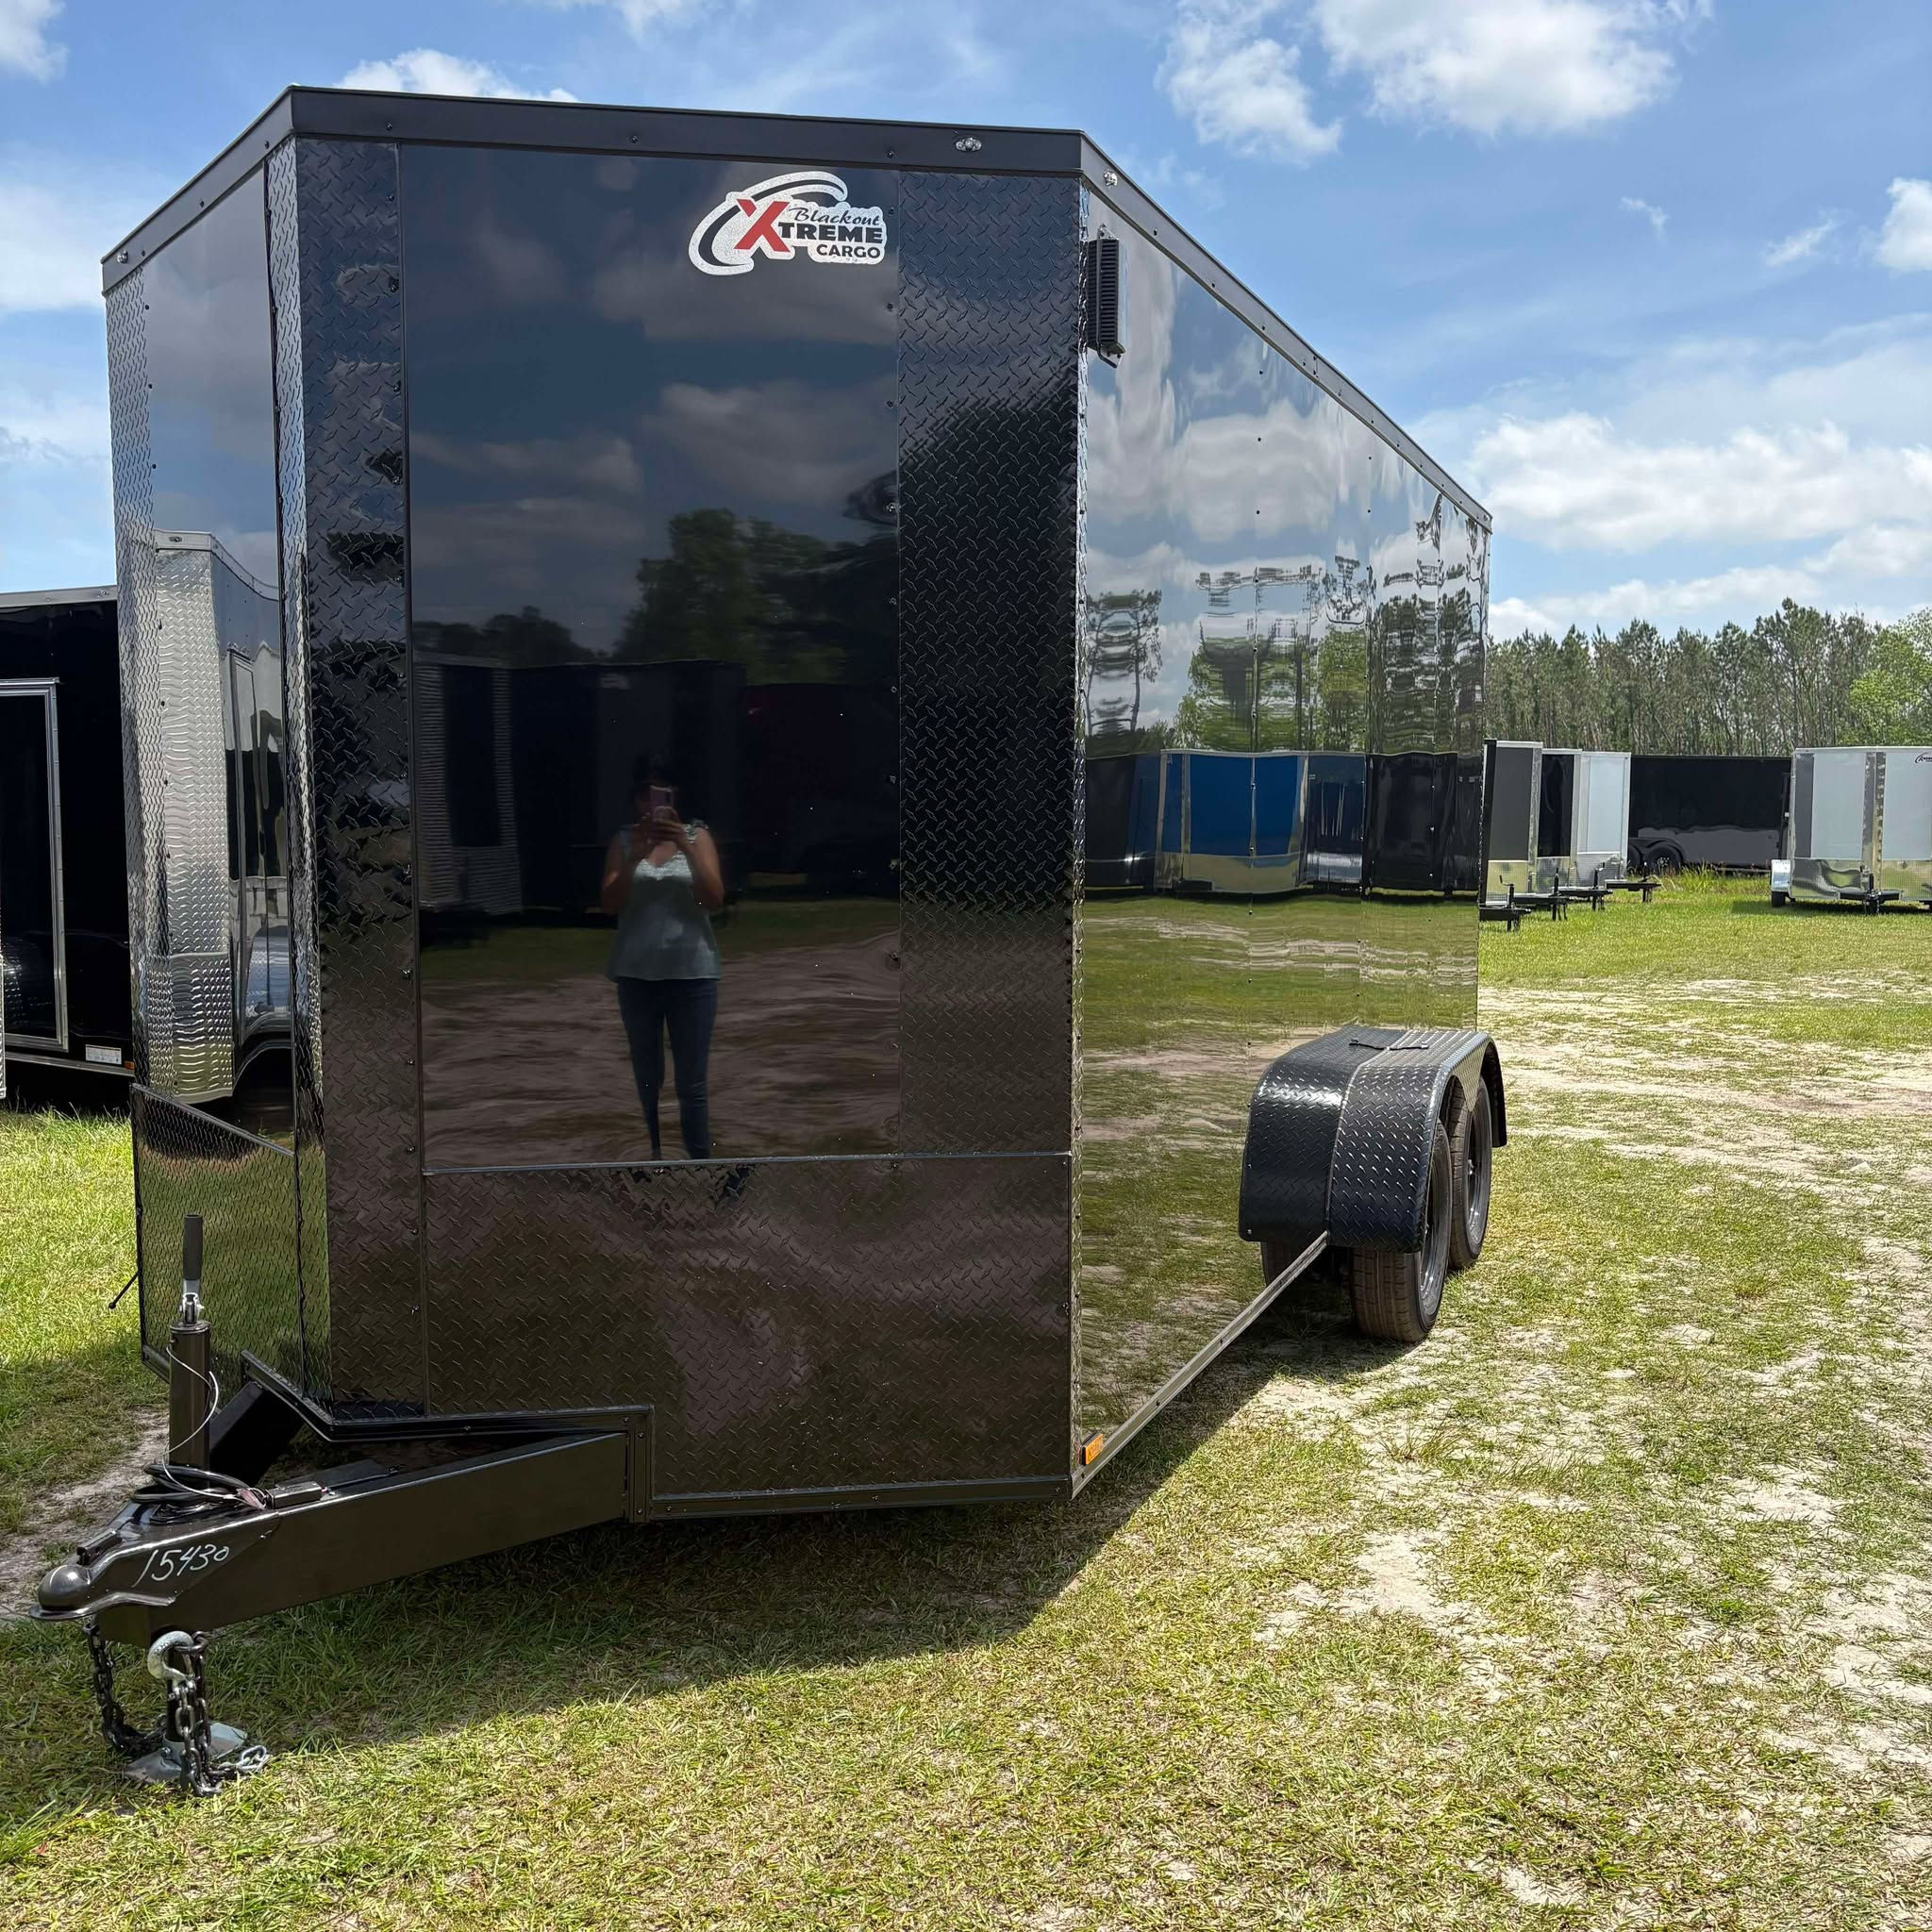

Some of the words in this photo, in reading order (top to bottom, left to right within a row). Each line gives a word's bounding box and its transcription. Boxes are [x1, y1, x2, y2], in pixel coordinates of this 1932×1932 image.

[790, 208, 879, 225] Blackout
[816, 243, 881, 259] CARGO
[132, 1543, 229, 1588] 15430
